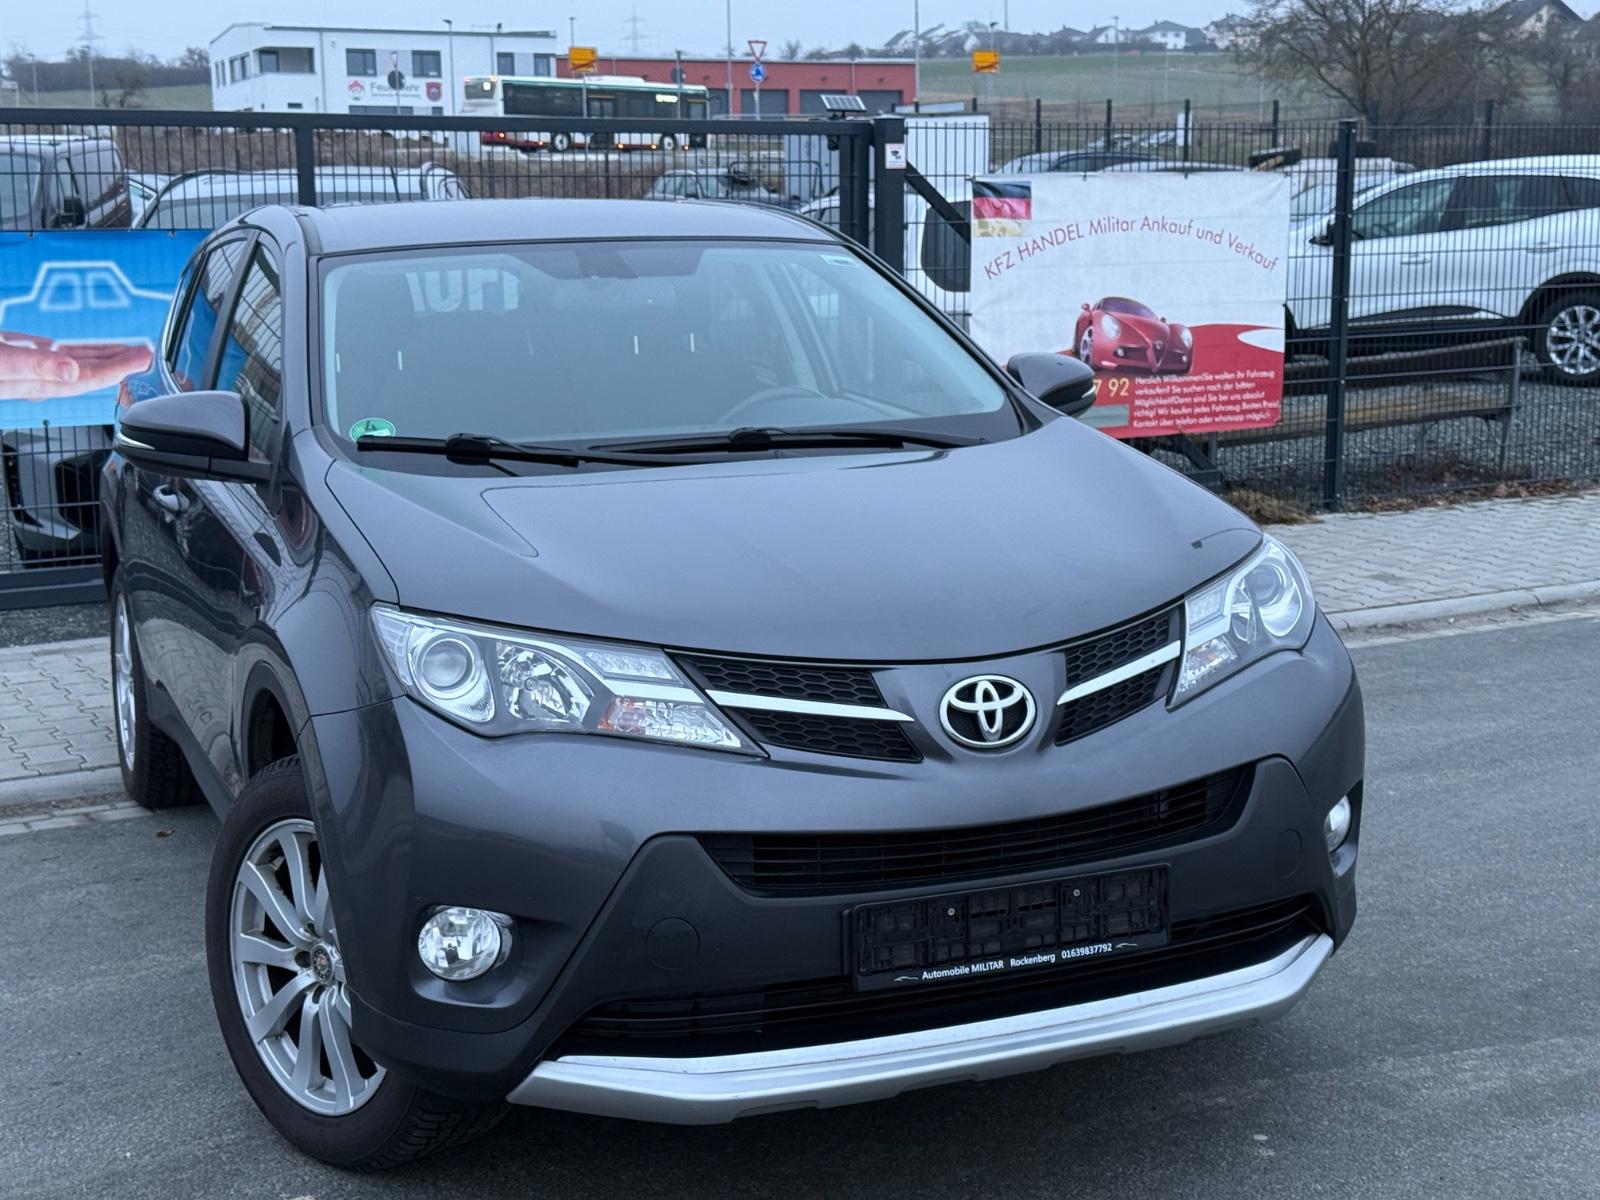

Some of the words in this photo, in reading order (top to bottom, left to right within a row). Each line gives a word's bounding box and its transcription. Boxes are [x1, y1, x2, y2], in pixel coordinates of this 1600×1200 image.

[984, 251, 1015, 279] KFZ
[1017, 223, 1084, 260] HANDEL
[1089, 215, 1136, 236] Militar
[1140, 215, 1194, 236] Ankauf
[1196, 228, 1224, 244] und
[1228, 232, 1279, 272] Verkauf
[1135, 375, 1161, 385] Herzlich
[1215, 371, 1235, 380] wollen
[1246, 369, 1275, 379] Fahrzeug
[1108, 377, 1130, 397] 92
[1171, 384, 1181, 393] Sie
[1183, 384, 1205, 393] suchen
[1206, 382, 1222, 391] nach
[1193, 394, 1207, 403] sind
[1208, 393, 1217, 402] Sie
[1218, 392, 1229, 401] bei
[1242, 391, 1265, 400] absolut
[1158, 406, 1169, 415] Wir
[1170, 406, 1192, 415] kaufen
[1133, 419, 1158, 428] Kontakt
[1159, 418, 1174, 427] über
[1198, 415, 1213, 424] oder
[922, 965, 970, 980] Automobile
[971, 960, 1004, 973] MILITAR
[1010, 952, 1055, 968] Rockenberg
[1061, 943, 1112, 959] 01639837792
